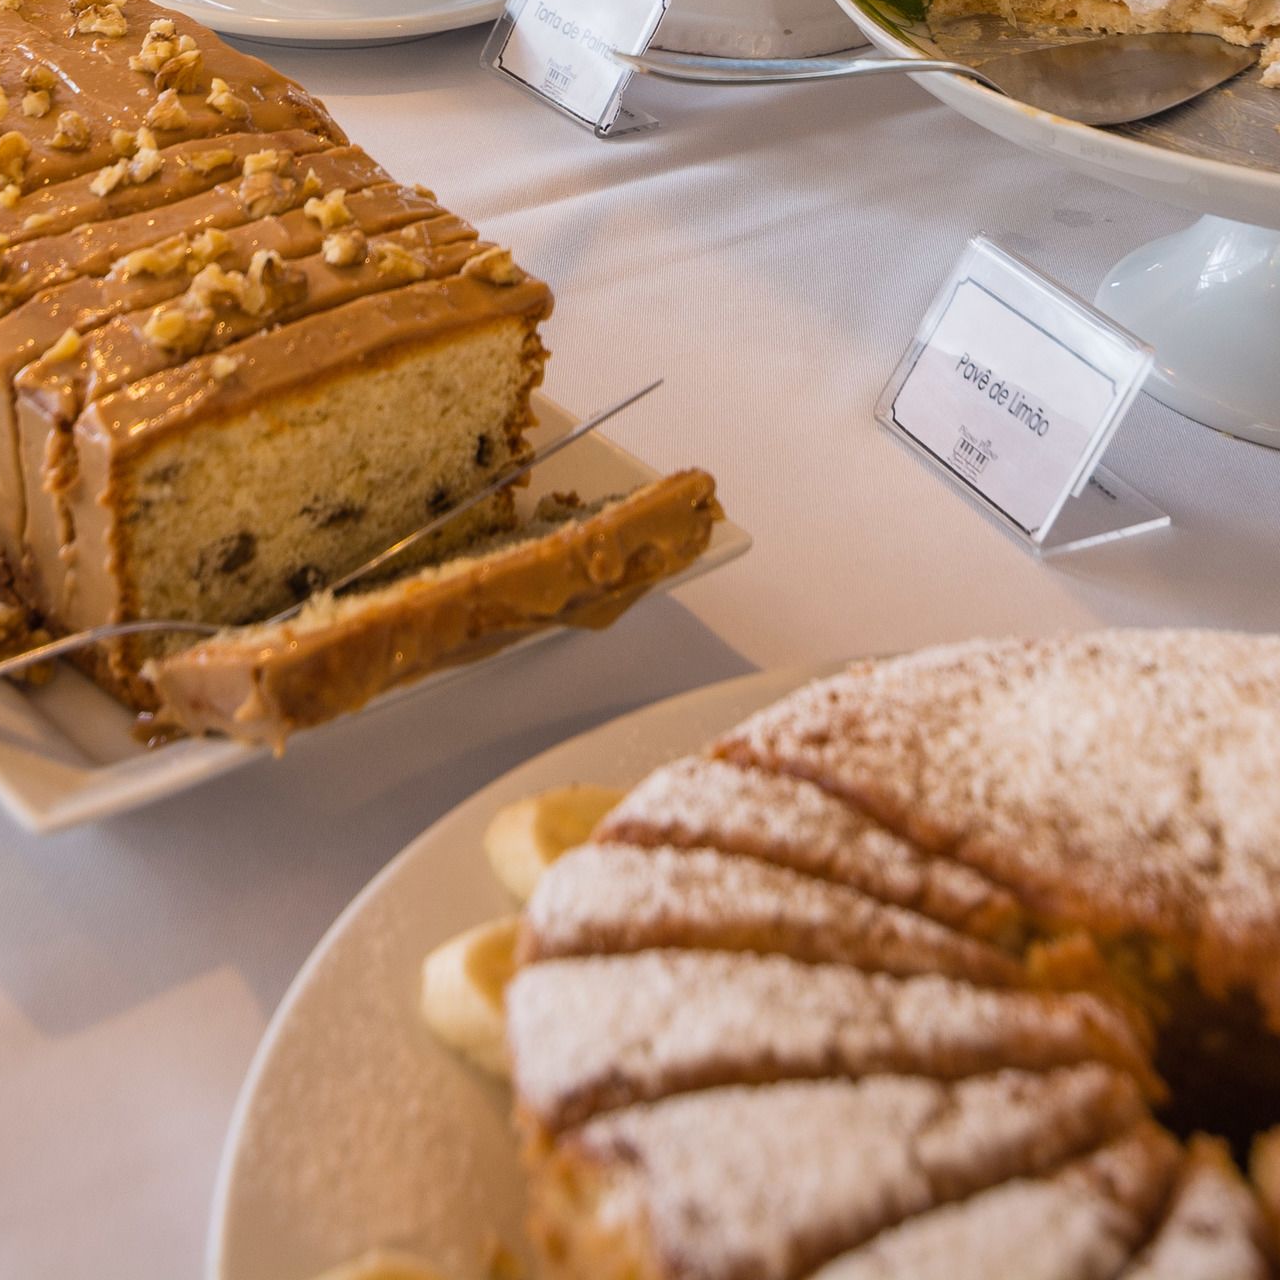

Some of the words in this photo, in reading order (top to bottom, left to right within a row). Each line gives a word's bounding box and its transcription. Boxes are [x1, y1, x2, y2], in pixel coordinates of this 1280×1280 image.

[534, 1, 562, 29] Torta
[562, 20, 579, 39] de
[955, 352, 992, 390] Pavê
[989, 381, 1009, 405] de
[1008, 392, 1050, 437] Limão
